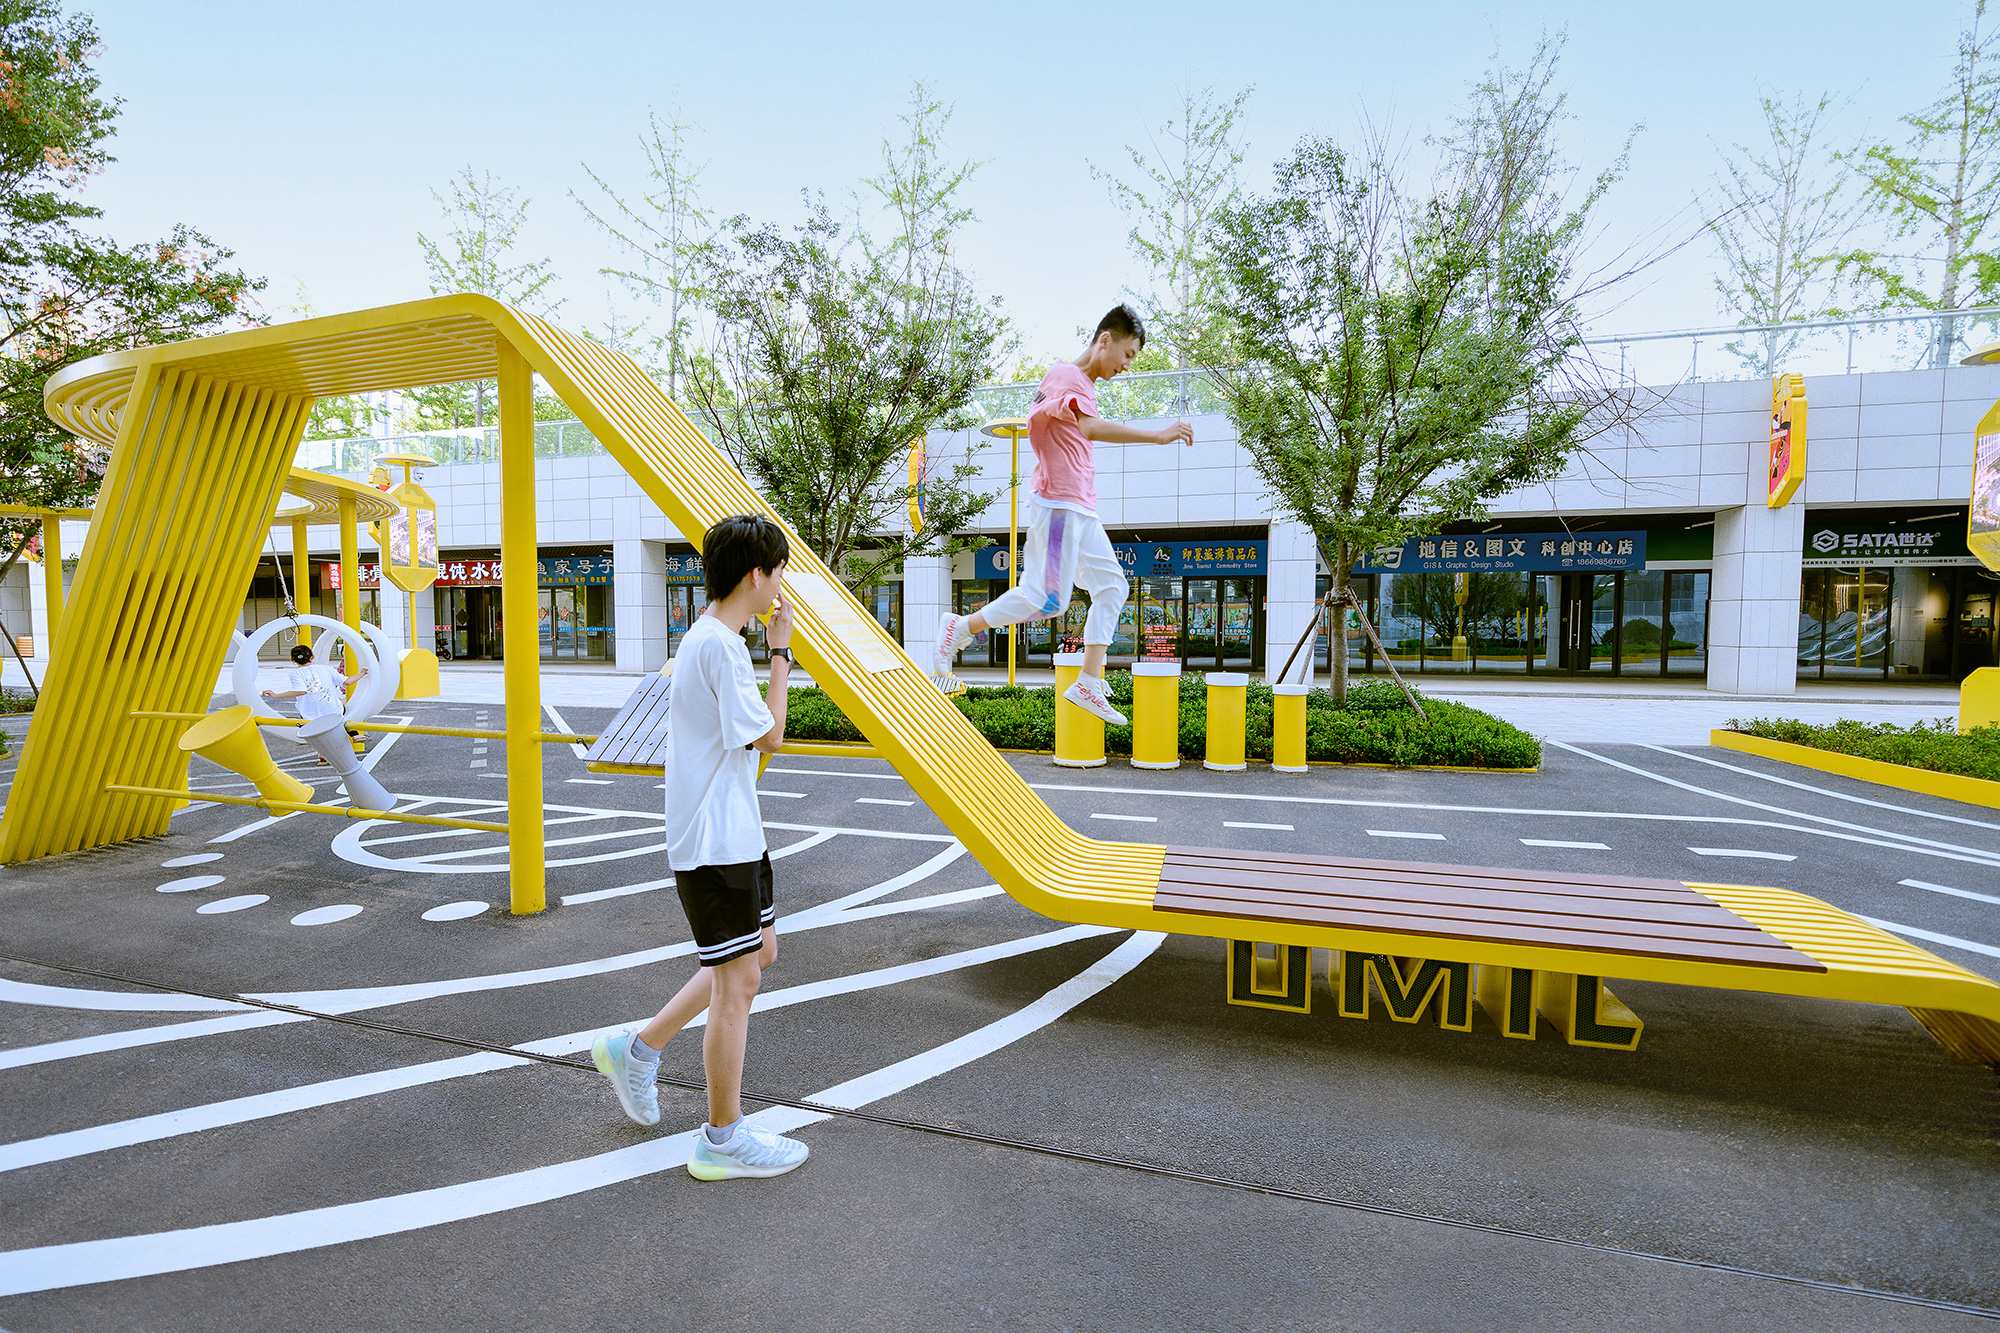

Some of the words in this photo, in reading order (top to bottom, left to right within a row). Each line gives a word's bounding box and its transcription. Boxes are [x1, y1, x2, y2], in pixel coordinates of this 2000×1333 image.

[1540, 539, 1634, 557] 科创中心店
[1445, 562, 1468, 570] Graphic
[1075, 682, 1106, 709] Feiyue
